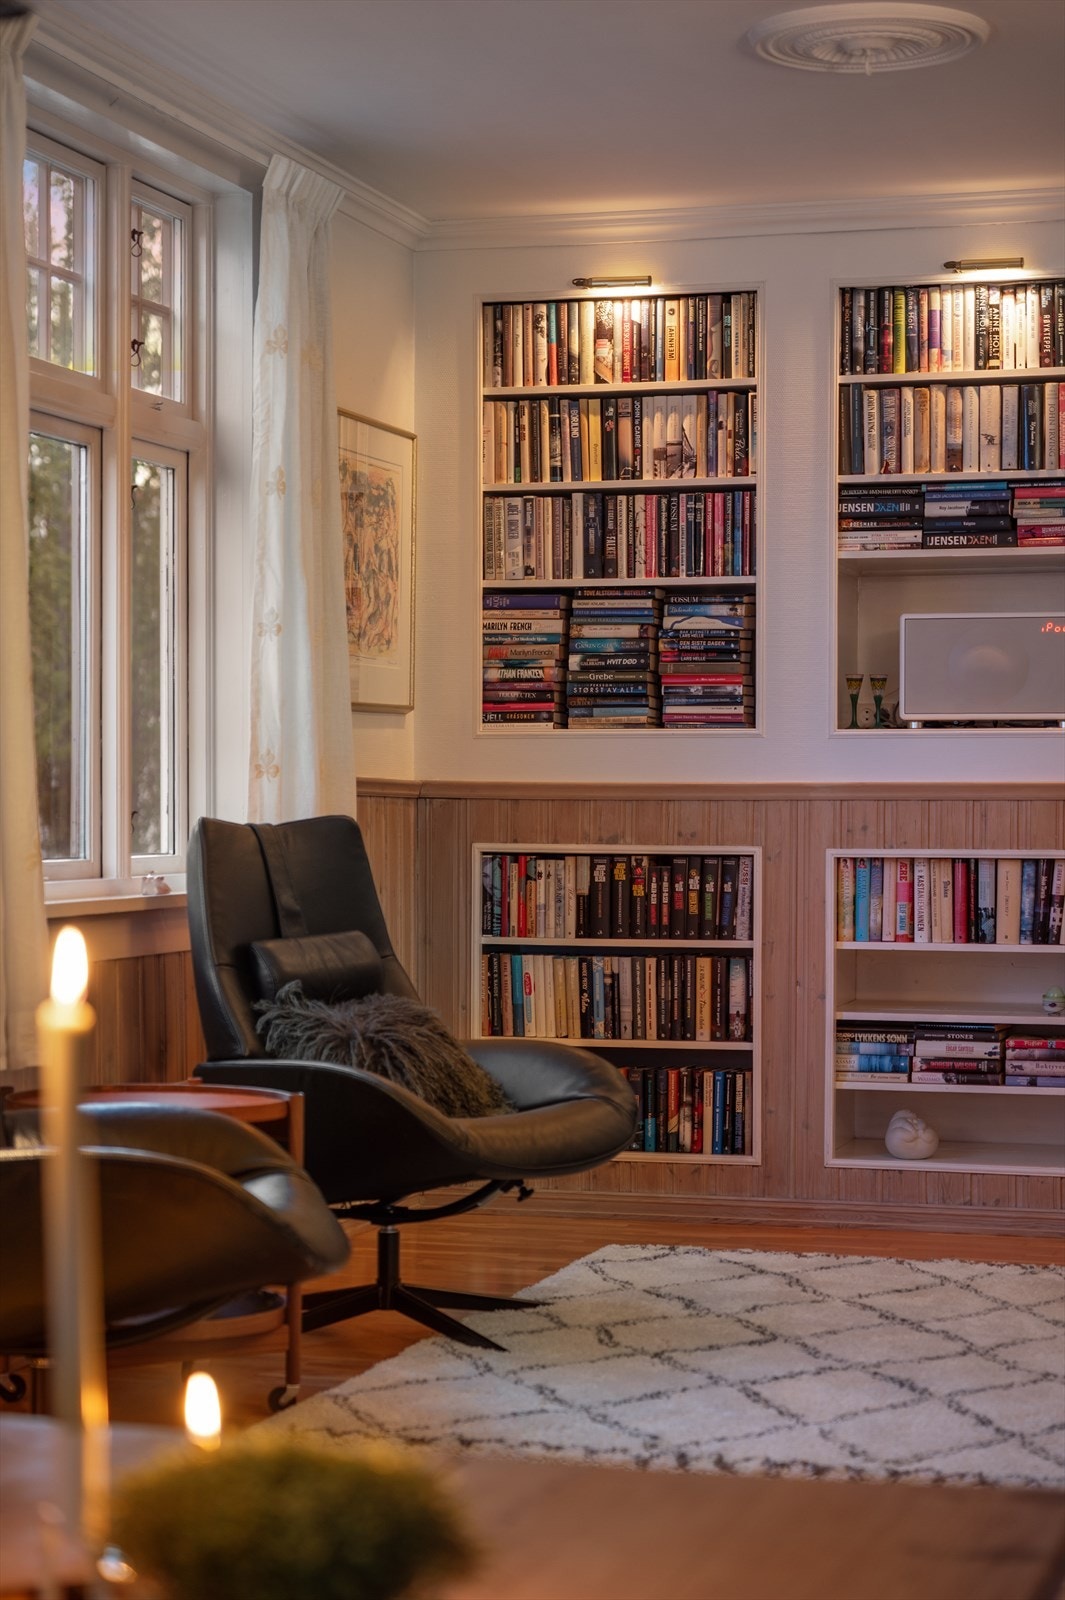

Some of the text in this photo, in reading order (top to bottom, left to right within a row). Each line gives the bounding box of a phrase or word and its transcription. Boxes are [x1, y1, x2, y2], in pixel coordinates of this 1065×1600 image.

[838, 503, 875, 513] JENSEN
[670, 498, 678, 531] FOSSUM
[507, 519, 519, 540] DICKER
[929, 535, 967, 546] JENSEN
[483, 622, 532, 631] MARILYN FRENCH
[517, 669, 545, 679] FRANZEN
[899, 861, 908, 882] ÆRE
[917, 875, 925, 932] KASTANJEMANNEN
[854, 1033, 886, 1042] LYKKENS
